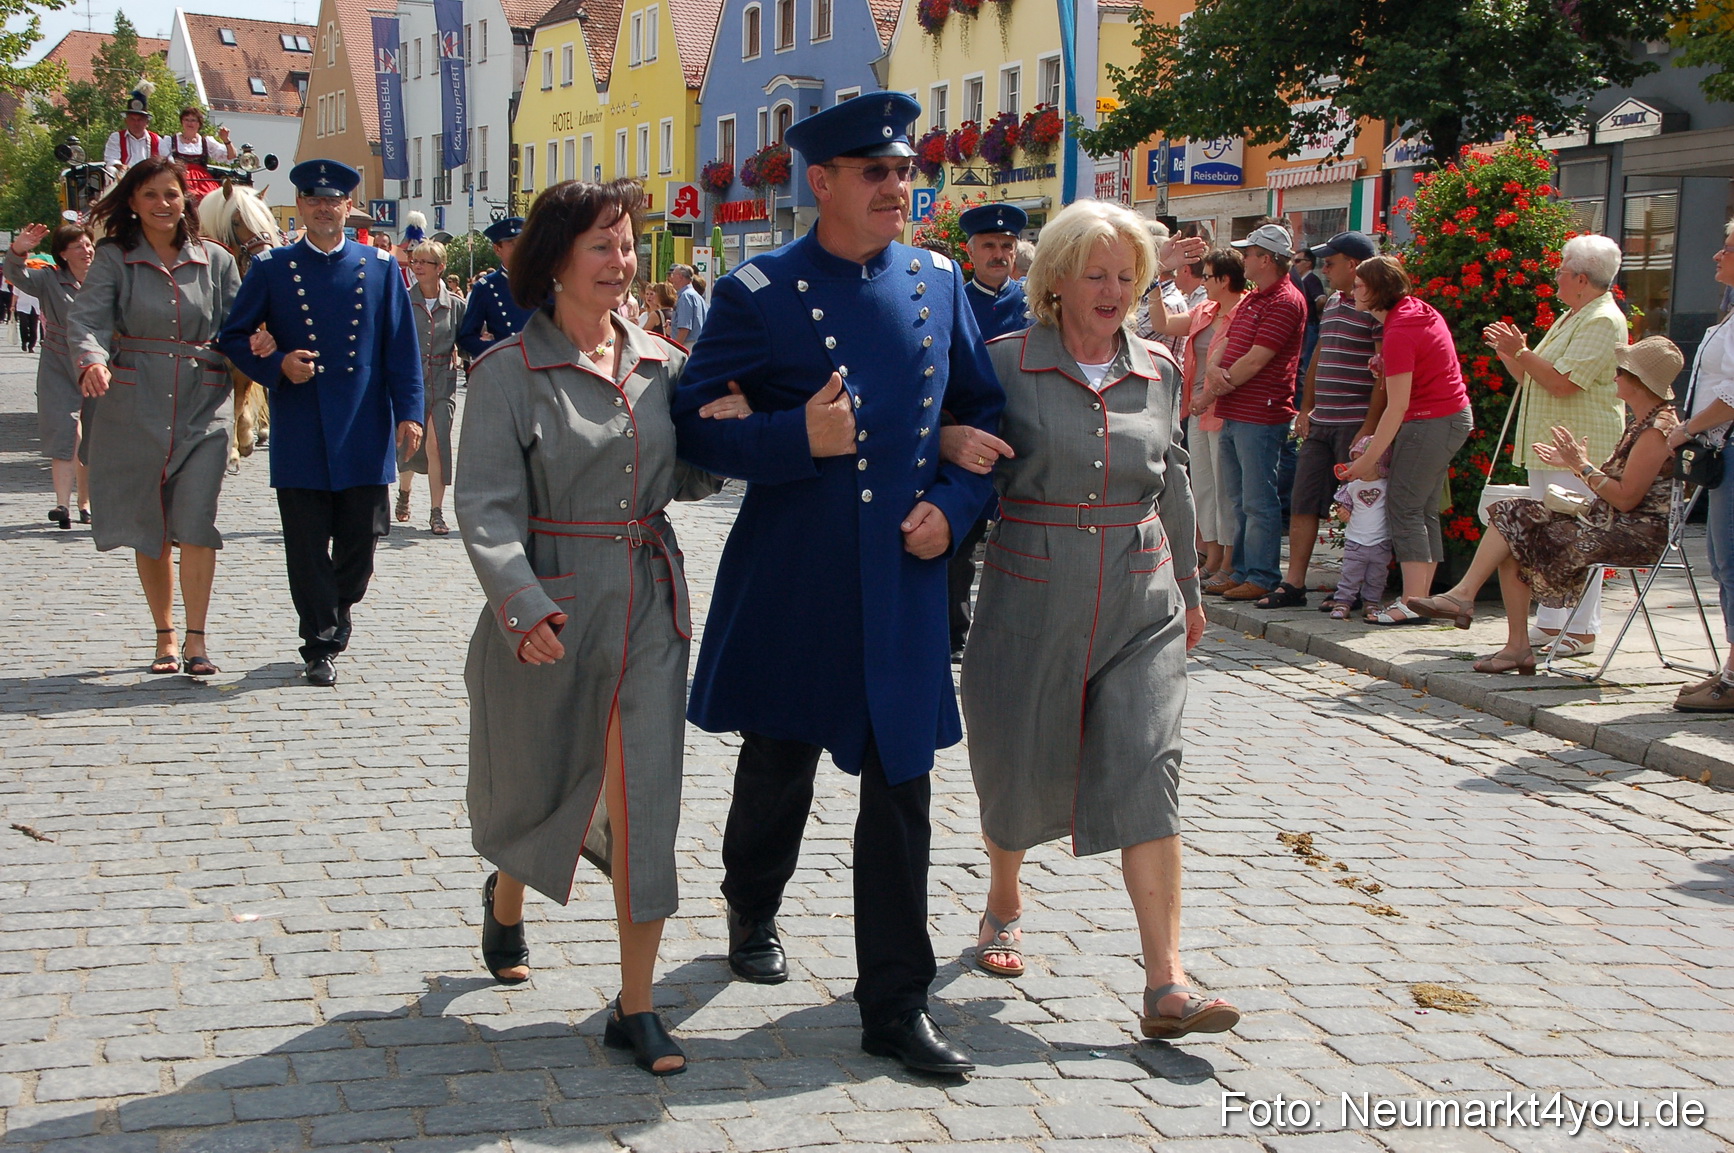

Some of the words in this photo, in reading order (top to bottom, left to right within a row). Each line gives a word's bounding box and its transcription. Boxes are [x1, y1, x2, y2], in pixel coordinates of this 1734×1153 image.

[450, 64, 463, 124] RUPPERT
[552, 111, 574, 132] HOTEL
[578, 108, 603, 126] Lehmeier
[1121, 148, 1130, 204] KINO
[1193, 171, 1239, 182] Reisebüro
[917, 191, 931, 218] P
